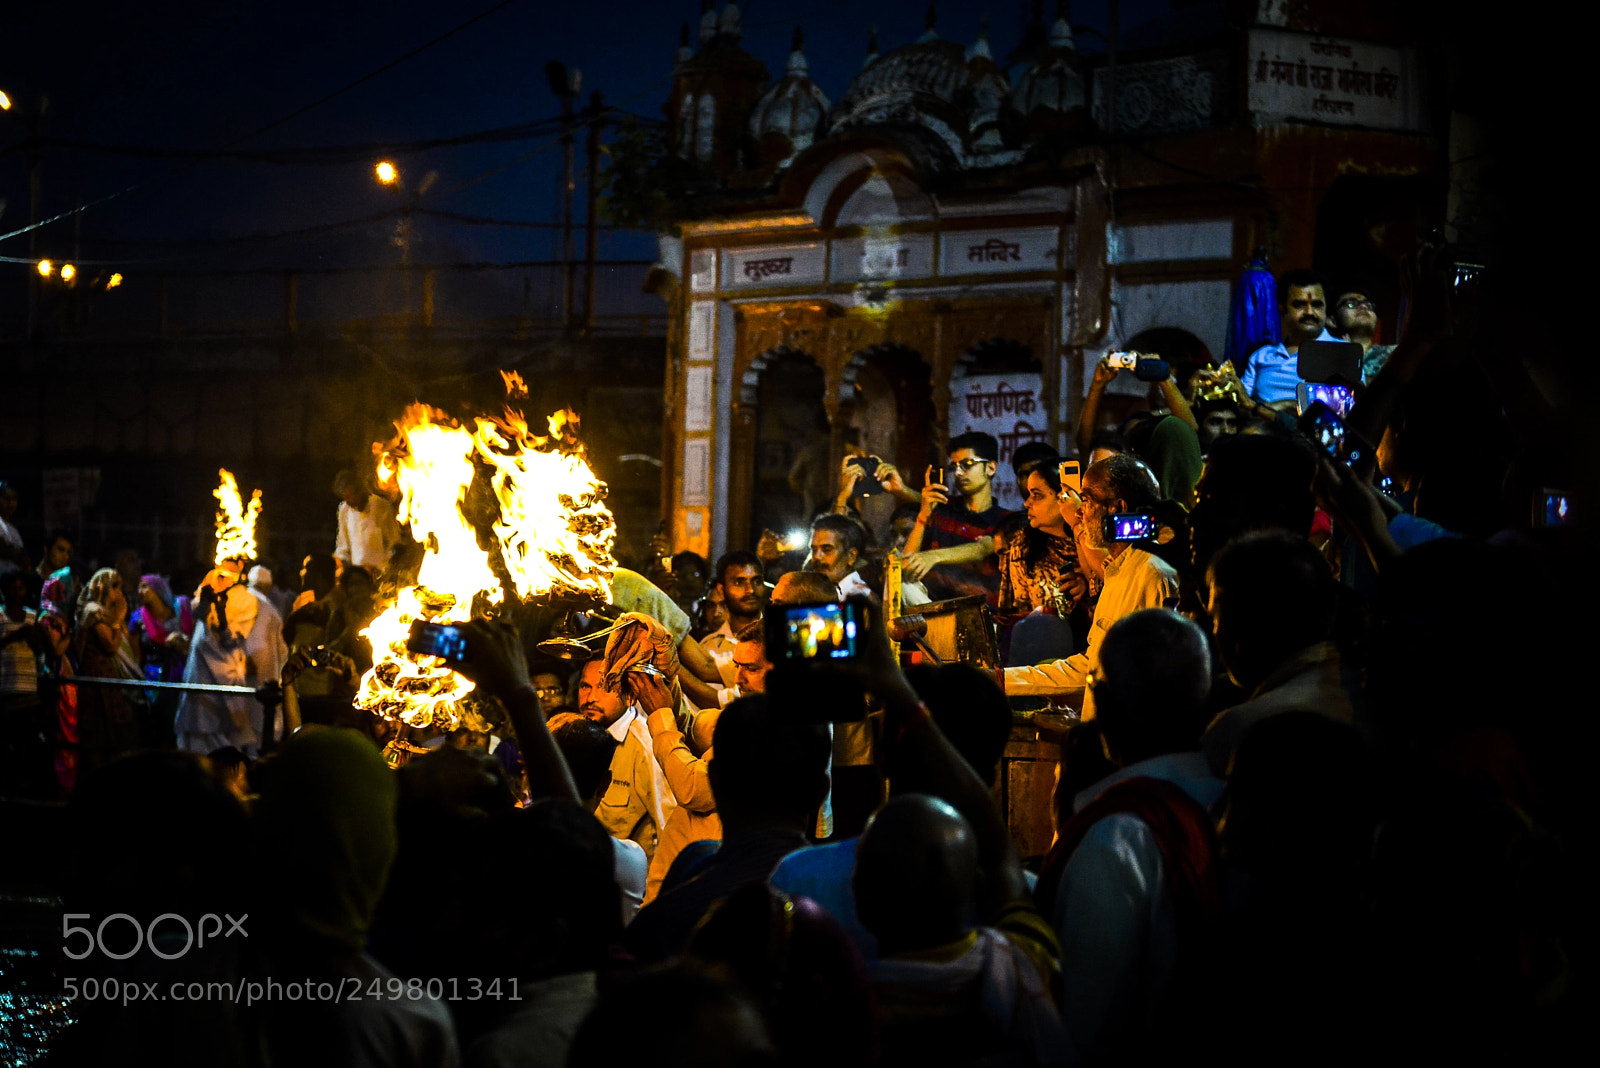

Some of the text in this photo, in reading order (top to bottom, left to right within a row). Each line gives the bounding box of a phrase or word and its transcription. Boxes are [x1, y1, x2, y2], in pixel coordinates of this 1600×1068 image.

[968, 238, 1021, 262] मन्दिर
[743, 257, 793, 281] मुख्य
[965, 380, 1037, 420] पौराणिक
